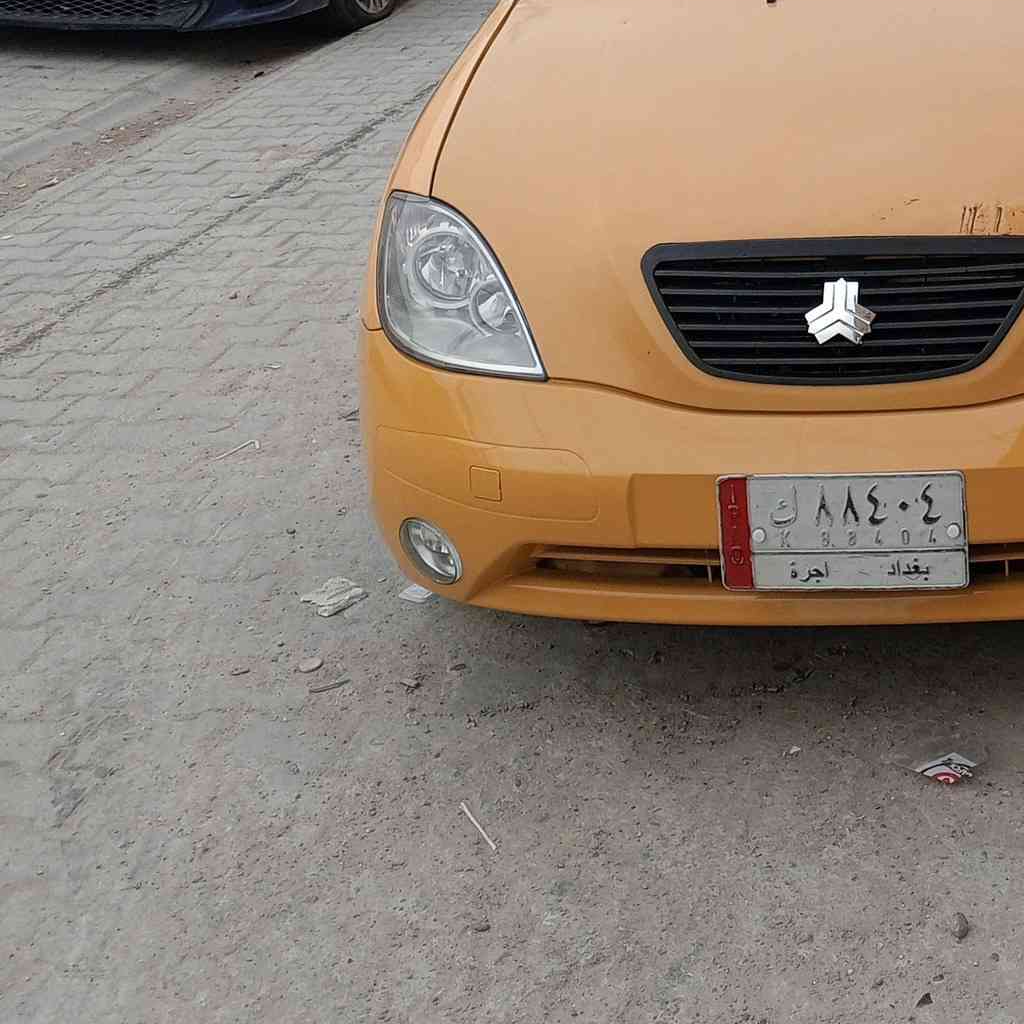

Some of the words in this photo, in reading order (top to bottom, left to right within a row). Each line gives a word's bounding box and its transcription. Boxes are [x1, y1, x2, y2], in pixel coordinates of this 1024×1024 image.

[815, 482, 942, 527] ٨٨٤٠٤
[789, 561, 830, 584] اجرة
[886, 558, 931, 581] بغداد
